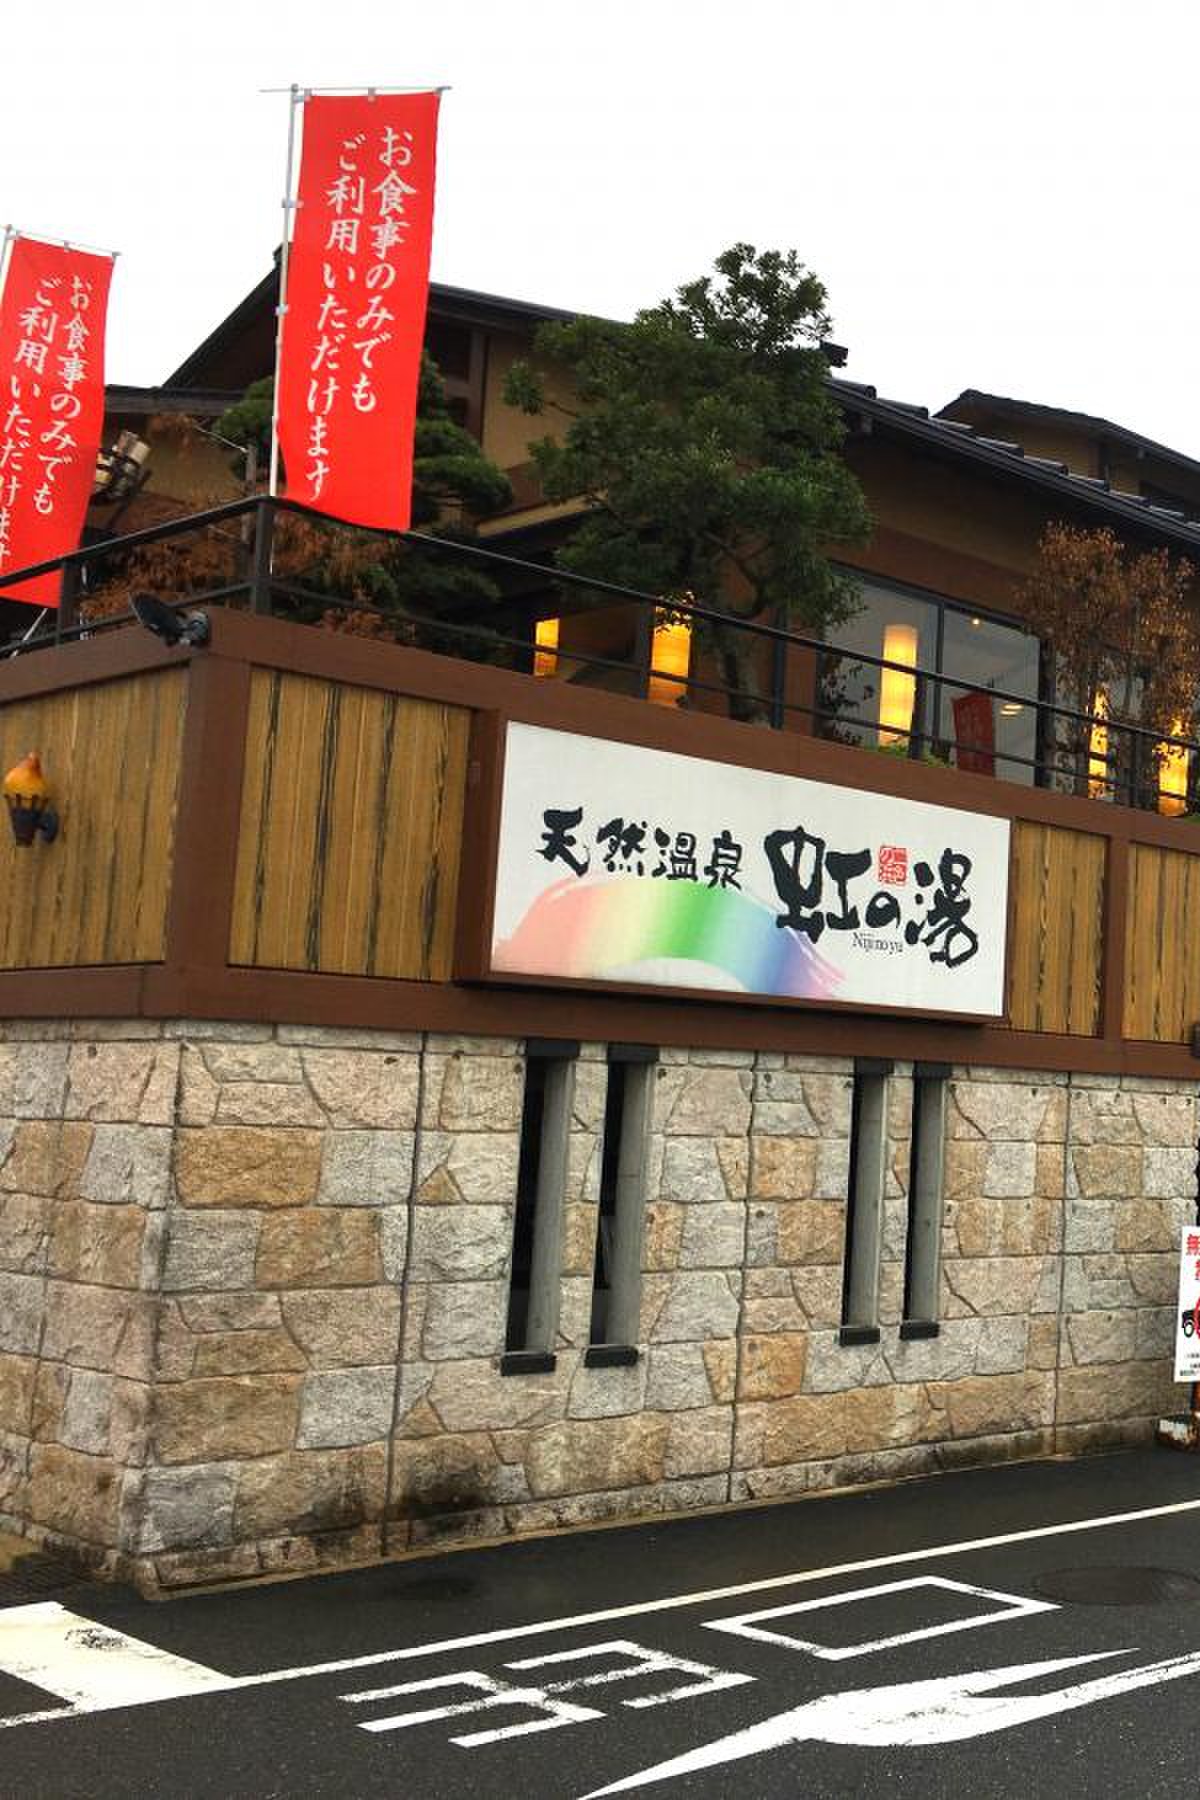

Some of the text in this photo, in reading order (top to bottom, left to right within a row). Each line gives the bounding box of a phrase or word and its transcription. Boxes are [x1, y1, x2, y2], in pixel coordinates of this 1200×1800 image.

[306, 132, 366, 501] ご利用いただけます
[352, 126, 416, 413] お食事のみでも
[33, 274, 93, 515] お食事のみでも
[536, 806, 742, 890] 天然温泉
[763, 825, 979, 969] 虹の湯
